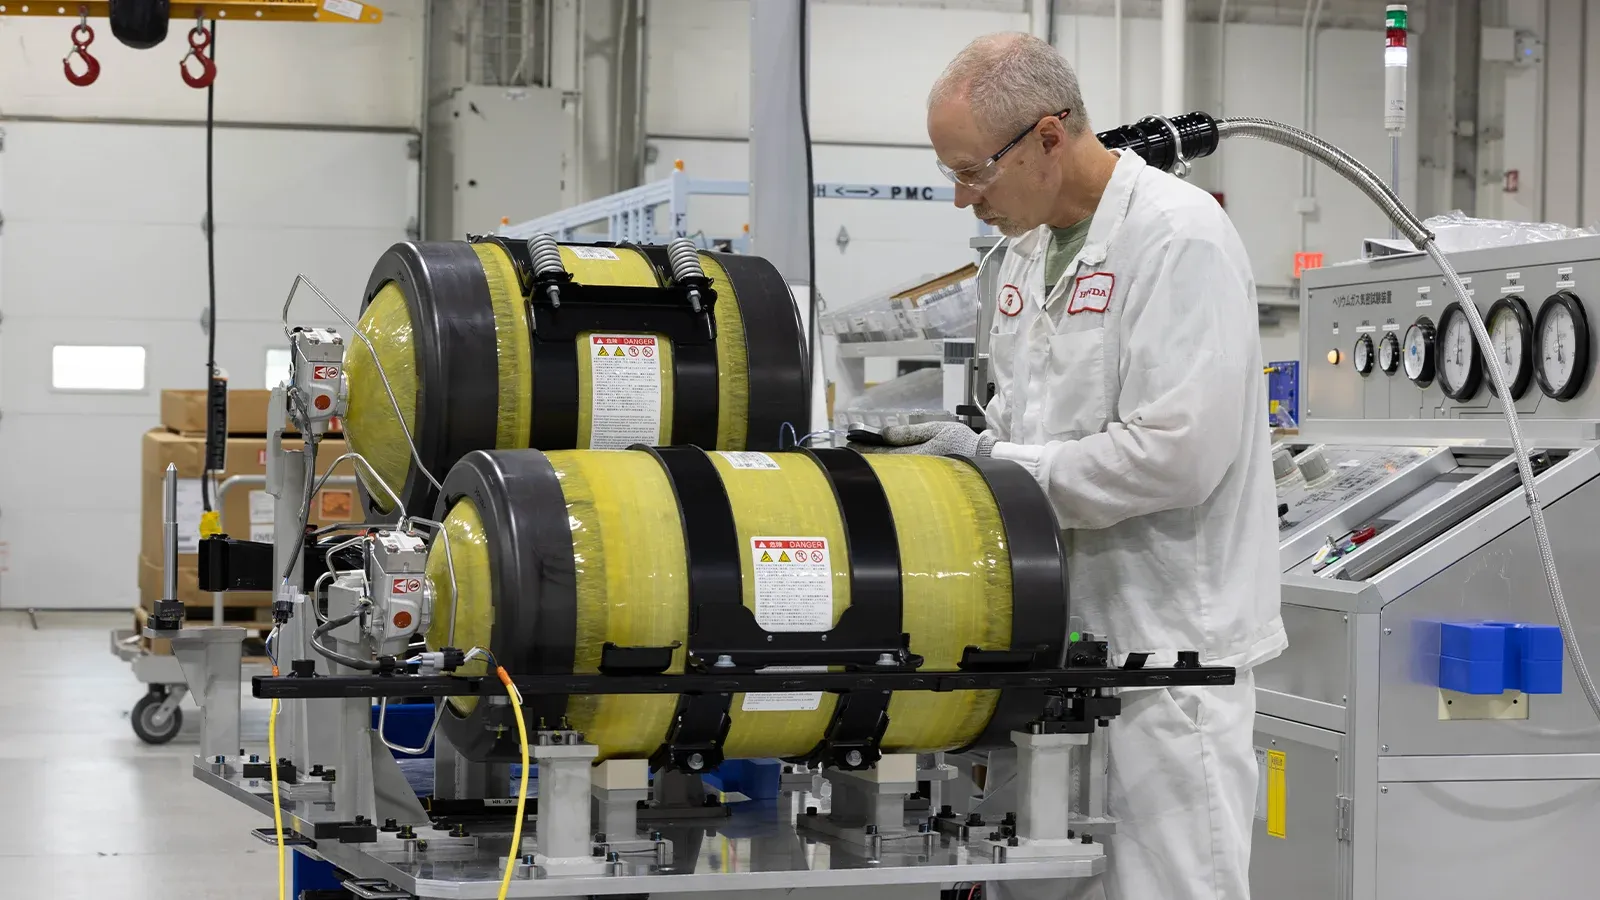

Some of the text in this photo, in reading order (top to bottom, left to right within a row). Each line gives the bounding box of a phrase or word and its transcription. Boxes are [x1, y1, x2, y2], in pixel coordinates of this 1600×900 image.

[891, 186, 934, 200] PMC
[623, 338, 654, 346] DANGER
[789, 541, 823, 549] DANGER
